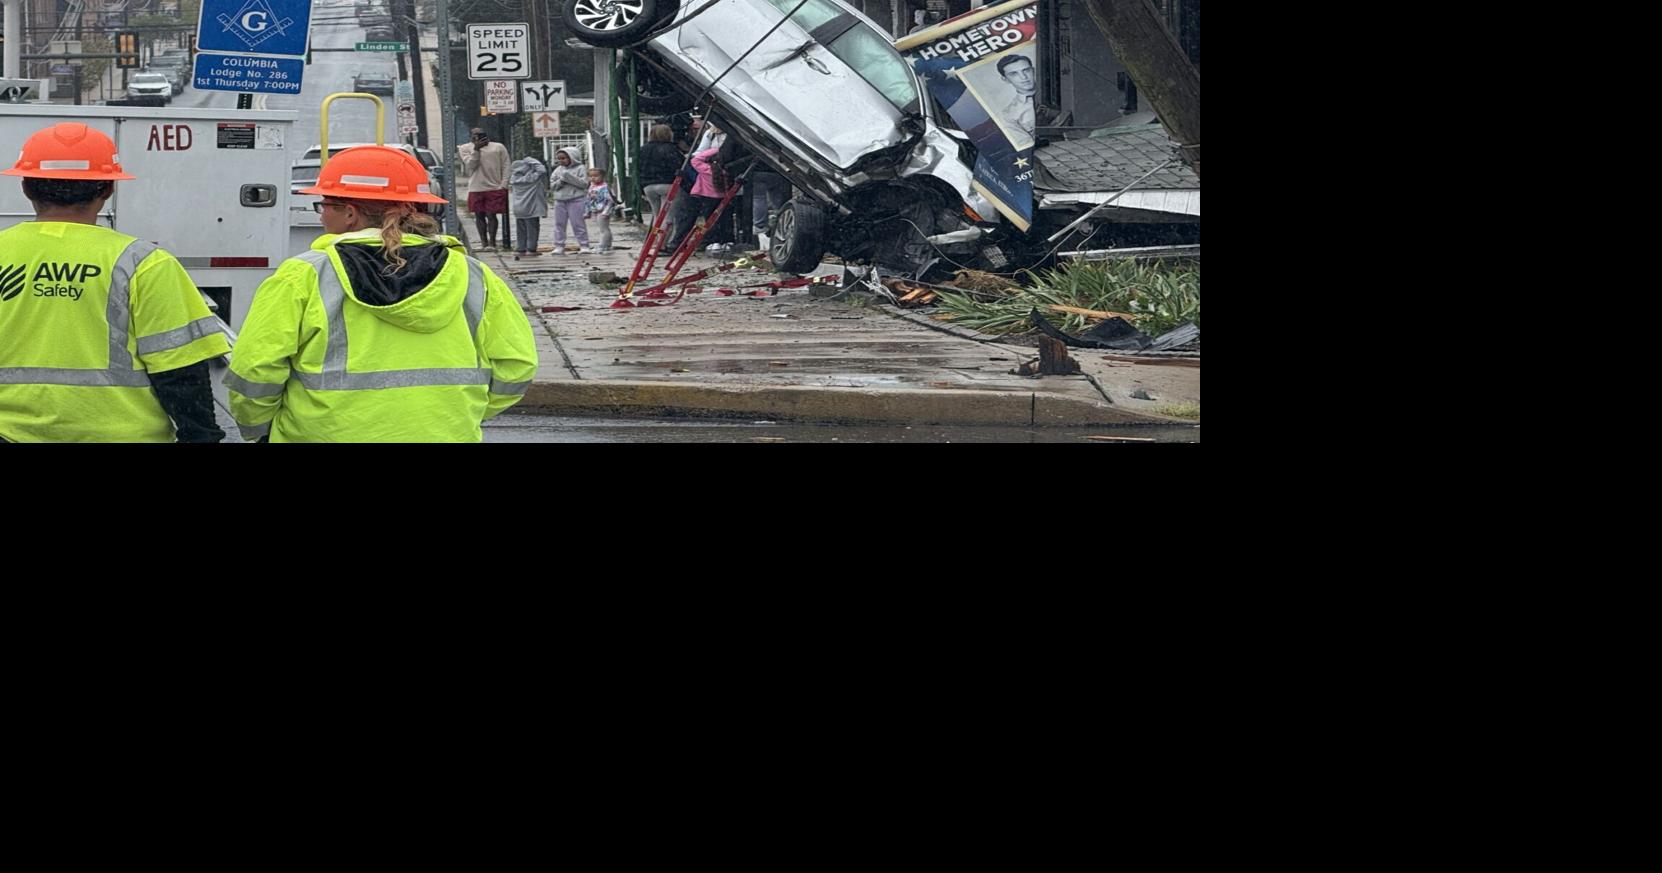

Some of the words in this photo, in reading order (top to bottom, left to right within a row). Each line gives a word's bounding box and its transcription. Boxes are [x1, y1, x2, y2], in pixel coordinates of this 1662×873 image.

[241, 11, 268, 32] G
[473, 29, 524, 38] SPEED
[919, 5, 1038, 61] HOMETOWN
[478, 40, 518, 49] LIMIT
[957, 29, 1023, 62] HERO
[222, 58, 278, 69] COLUMBIA
[476, 52, 522, 72] 25
[210, 68, 242, 78] Lodge
[246, 70, 264, 79] No.
[268, 71, 288, 80] 286
[197, 77, 210, 86] 1st
[215, 78, 260, 90] Thursday
[264, 81, 300, 91] 7:00PM
[493, 81, 507, 89] NO
[487, 88, 514, 96] PARKING
[147, 124, 193, 151] AED
[1014, 169, 1034, 183] 36T
[32, 262, 102, 283] AWP
[33, 283, 84, 301] Safety
